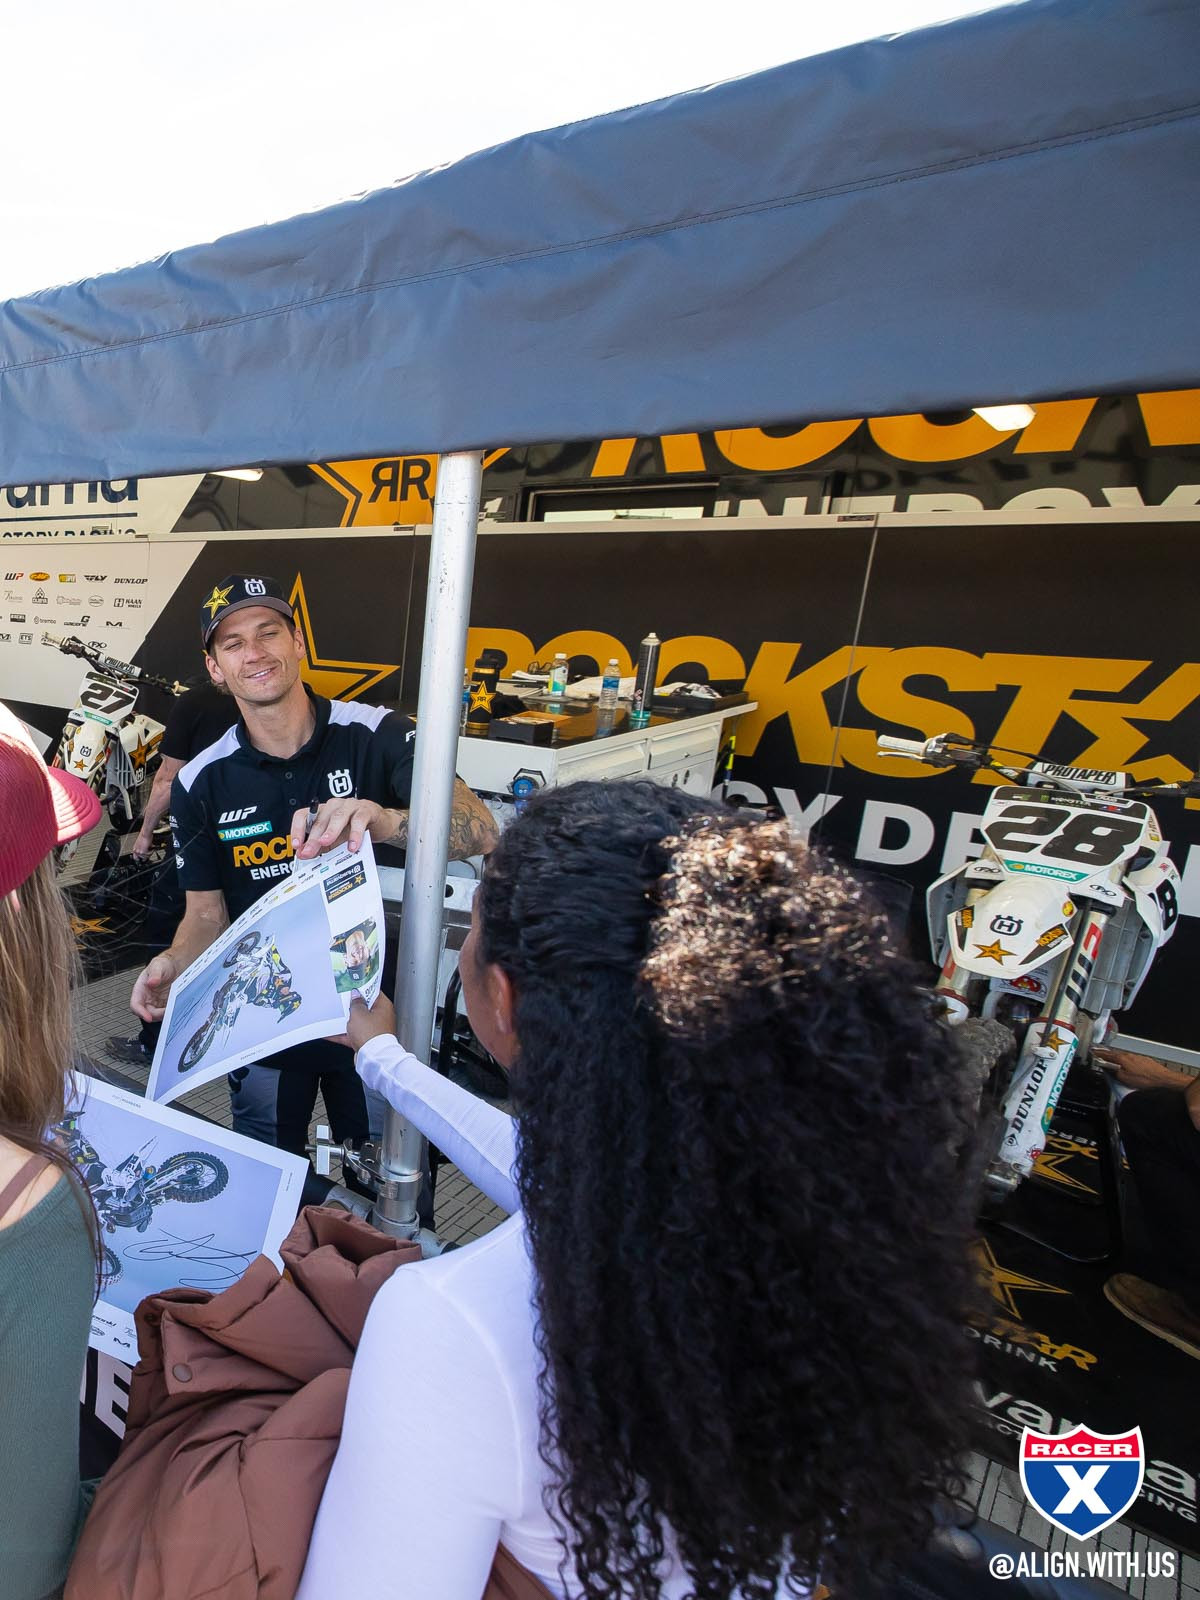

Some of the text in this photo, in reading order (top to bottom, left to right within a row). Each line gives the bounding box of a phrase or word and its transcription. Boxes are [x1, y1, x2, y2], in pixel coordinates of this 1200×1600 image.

[5, 572, 24, 581] WP
[84, 574, 108, 582] FLY
[80, 682, 136, 715] 27
[1042, 764, 1116, 785] PROTAPER
[218, 806, 258, 824] WP
[224, 823, 269, 840] MOTOREX
[984, 804, 1144, 867] 28
[1024, 863, 1079, 881] MOTOREX
[1011, 1058, 1049, 1133] DUNLOP
